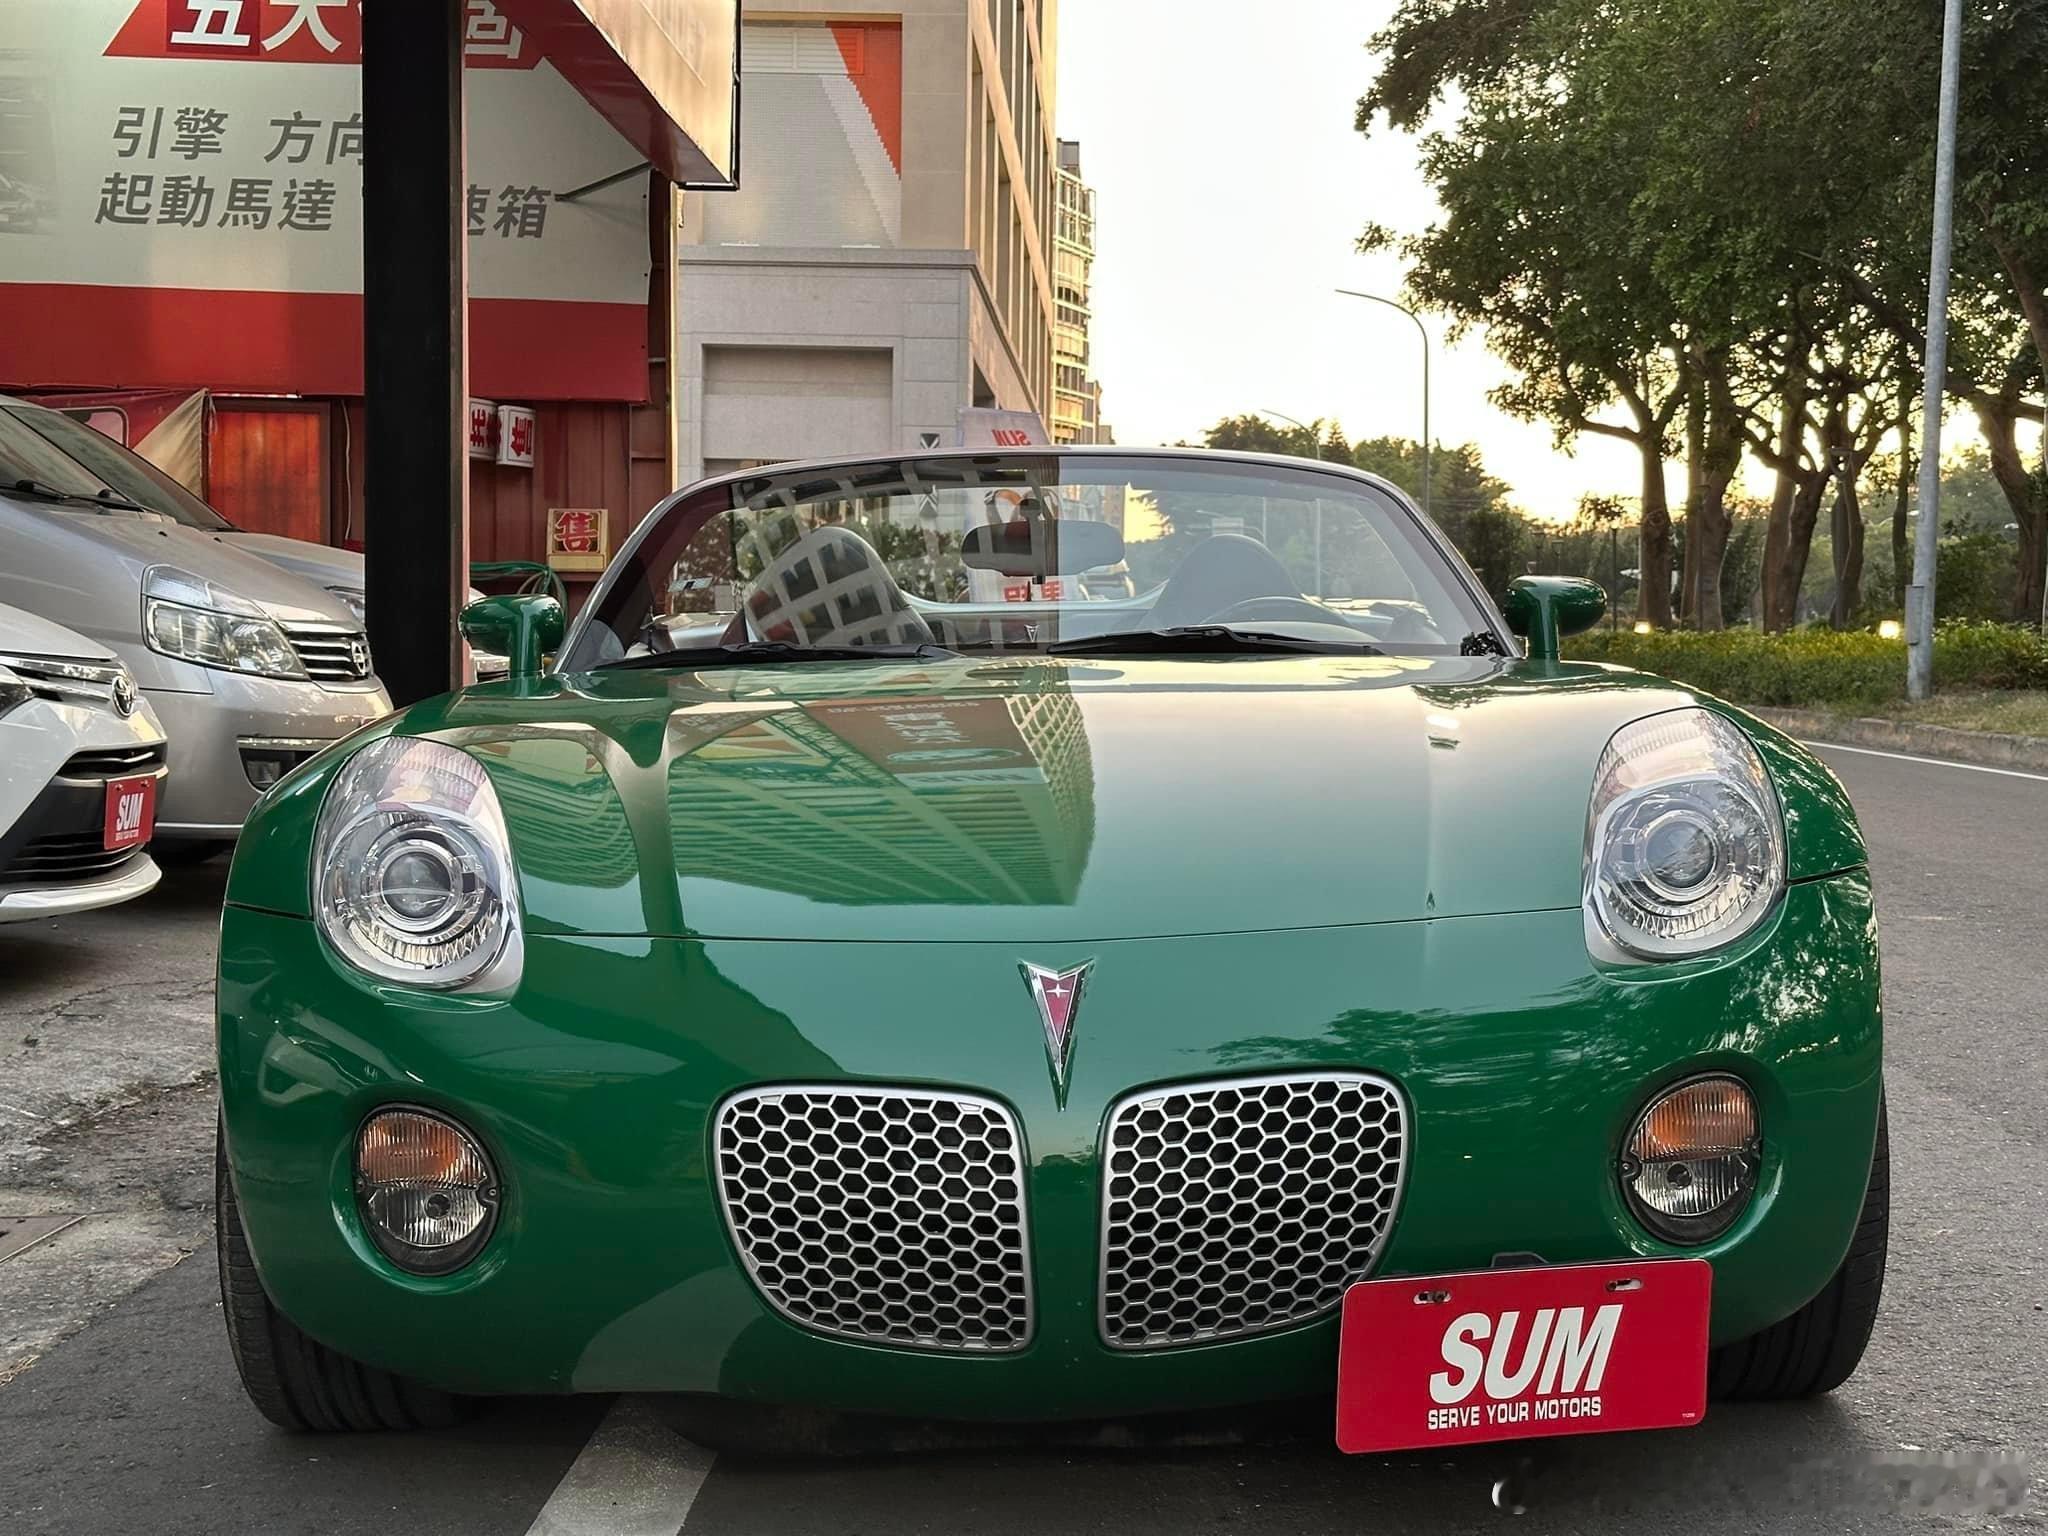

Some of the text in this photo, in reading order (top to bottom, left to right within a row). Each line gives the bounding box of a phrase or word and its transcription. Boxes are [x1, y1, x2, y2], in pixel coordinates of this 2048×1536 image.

[113, 107, 228, 160] 引擎
[94, 172, 337, 231] 起動馬達
[554, 511, 598, 553] 售
[116, 793, 144, 832] SUM
[1429, 1304, 1623, 1404] SUM
[1428, 1396, 1601, 1430] SERVE YOUR MOTORS
